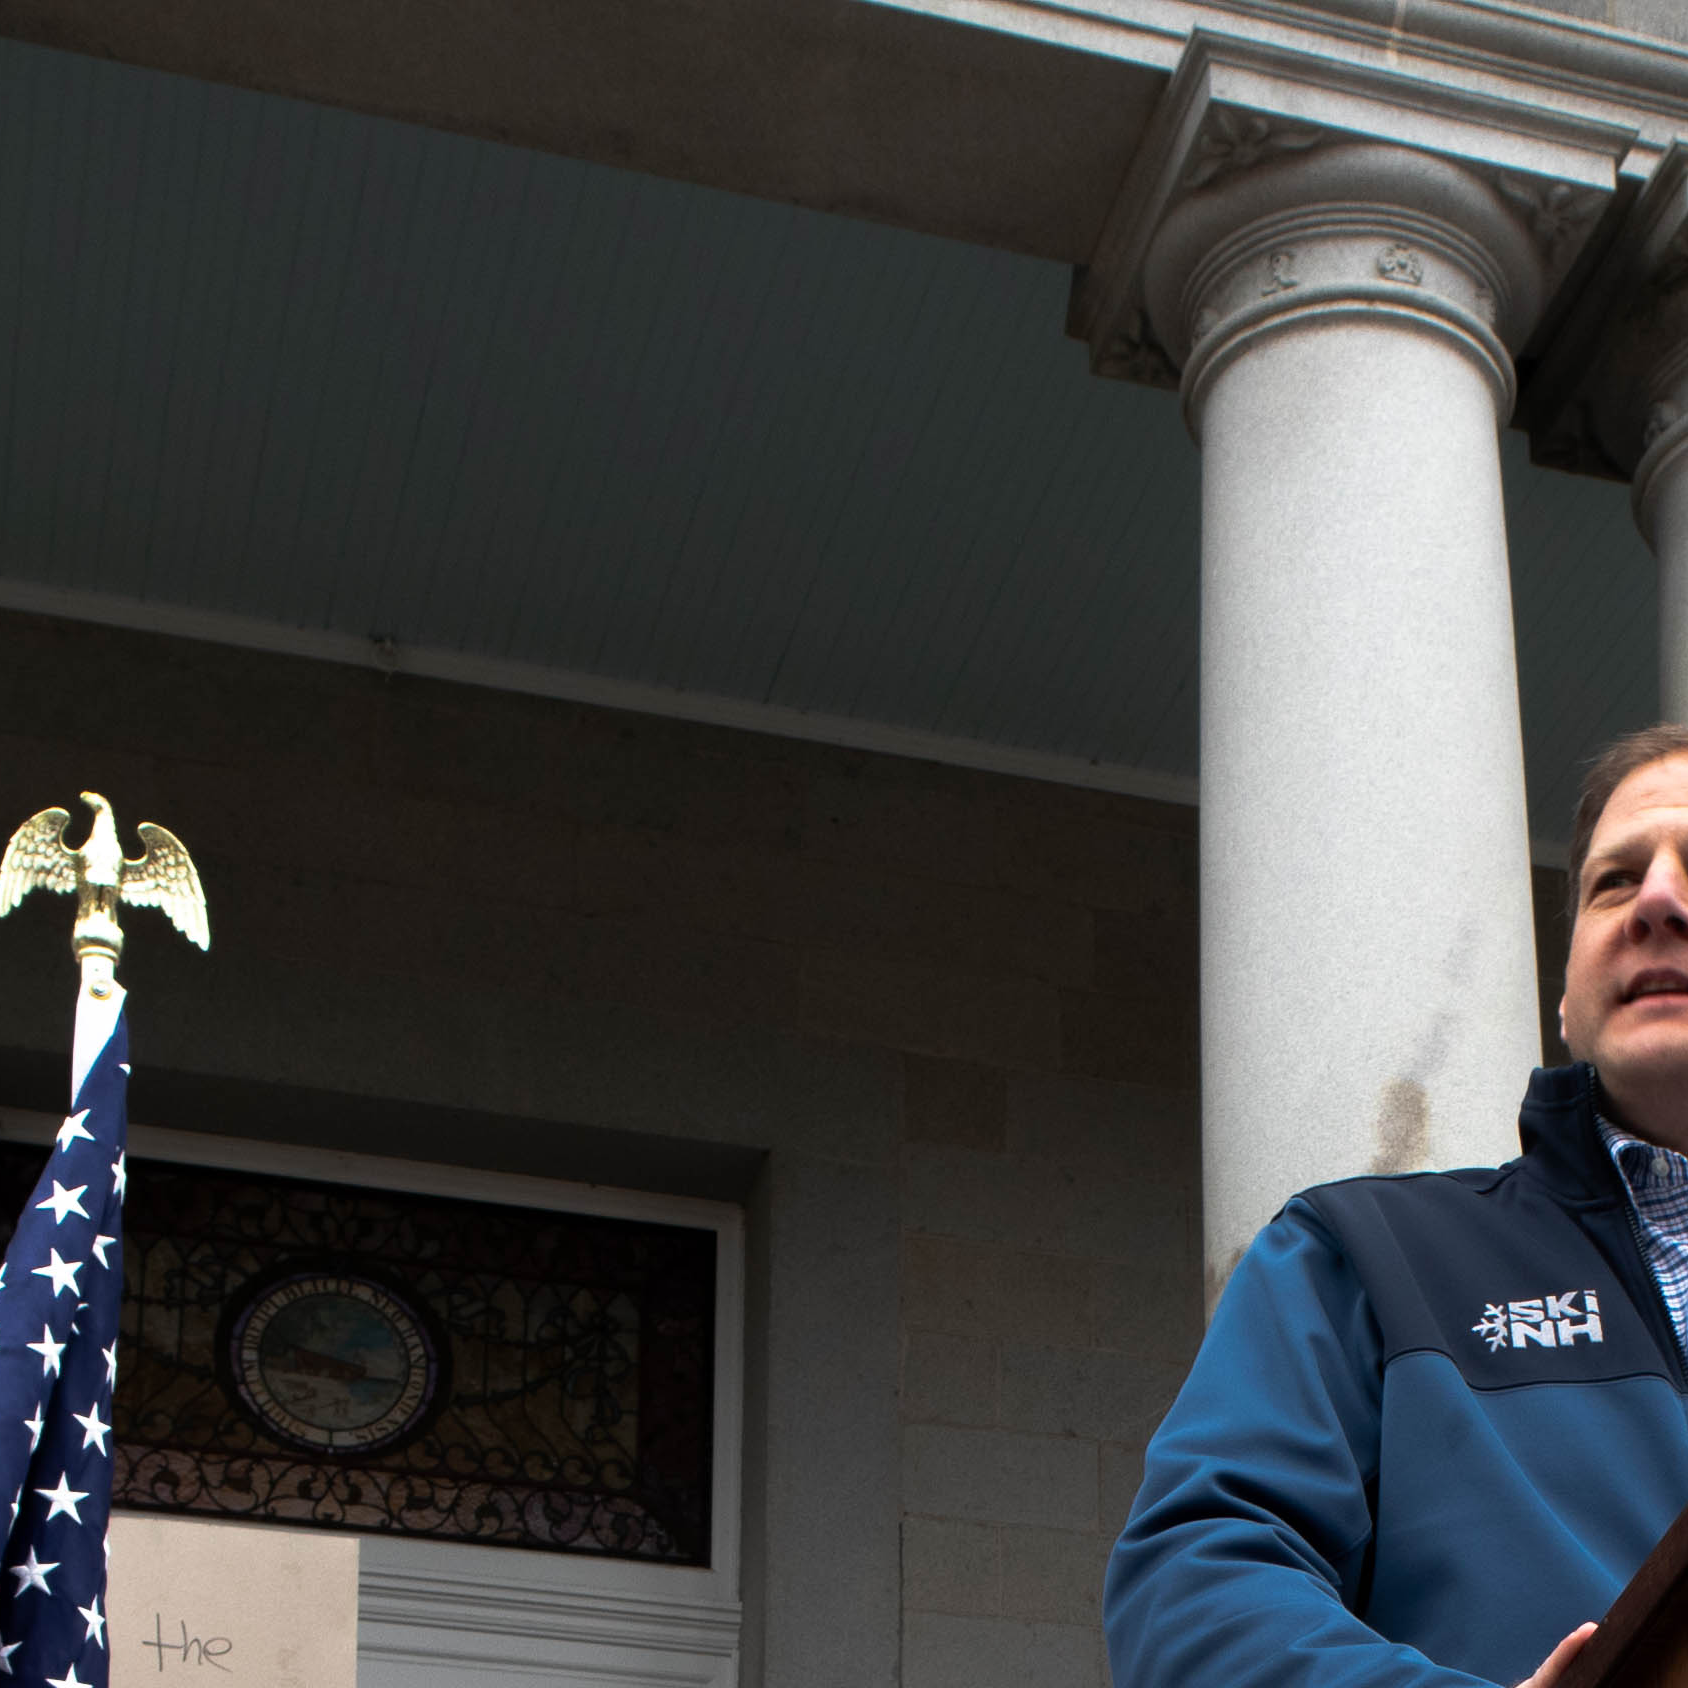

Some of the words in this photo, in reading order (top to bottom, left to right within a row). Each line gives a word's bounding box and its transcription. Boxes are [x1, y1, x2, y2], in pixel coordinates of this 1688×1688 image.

[1508, 1290, 1600, 1322] SKI
[1511, 1313, 1603, 1348] NH
[142, 1611, 234, 1674] the
